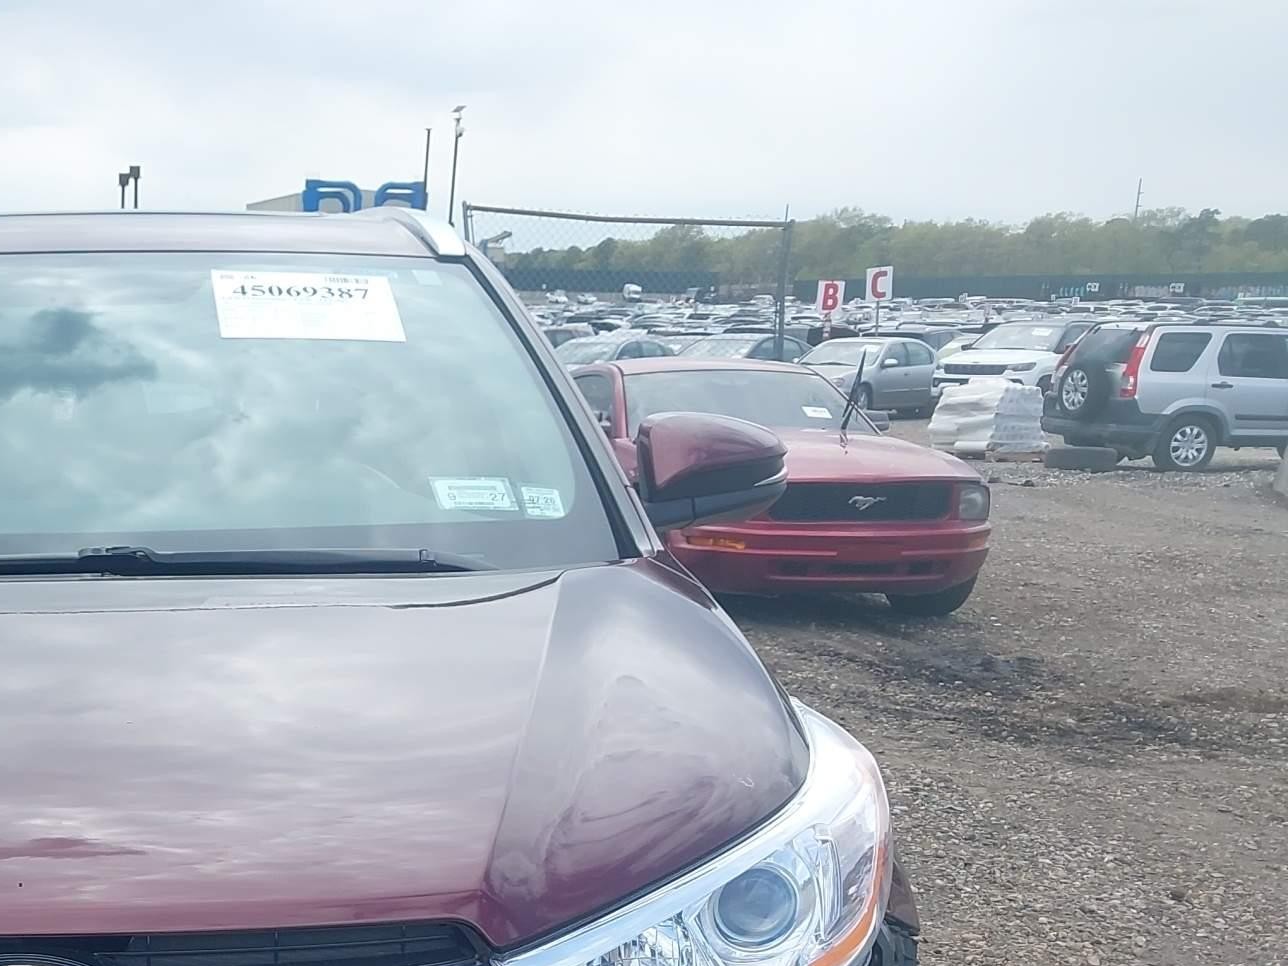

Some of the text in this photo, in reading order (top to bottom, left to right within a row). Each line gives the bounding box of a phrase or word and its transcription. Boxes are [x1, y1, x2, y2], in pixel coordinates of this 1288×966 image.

[232, 284, 369, 300] 45069387
[822, 283, 839, 310] B
[872, 271, 887, 298] C
